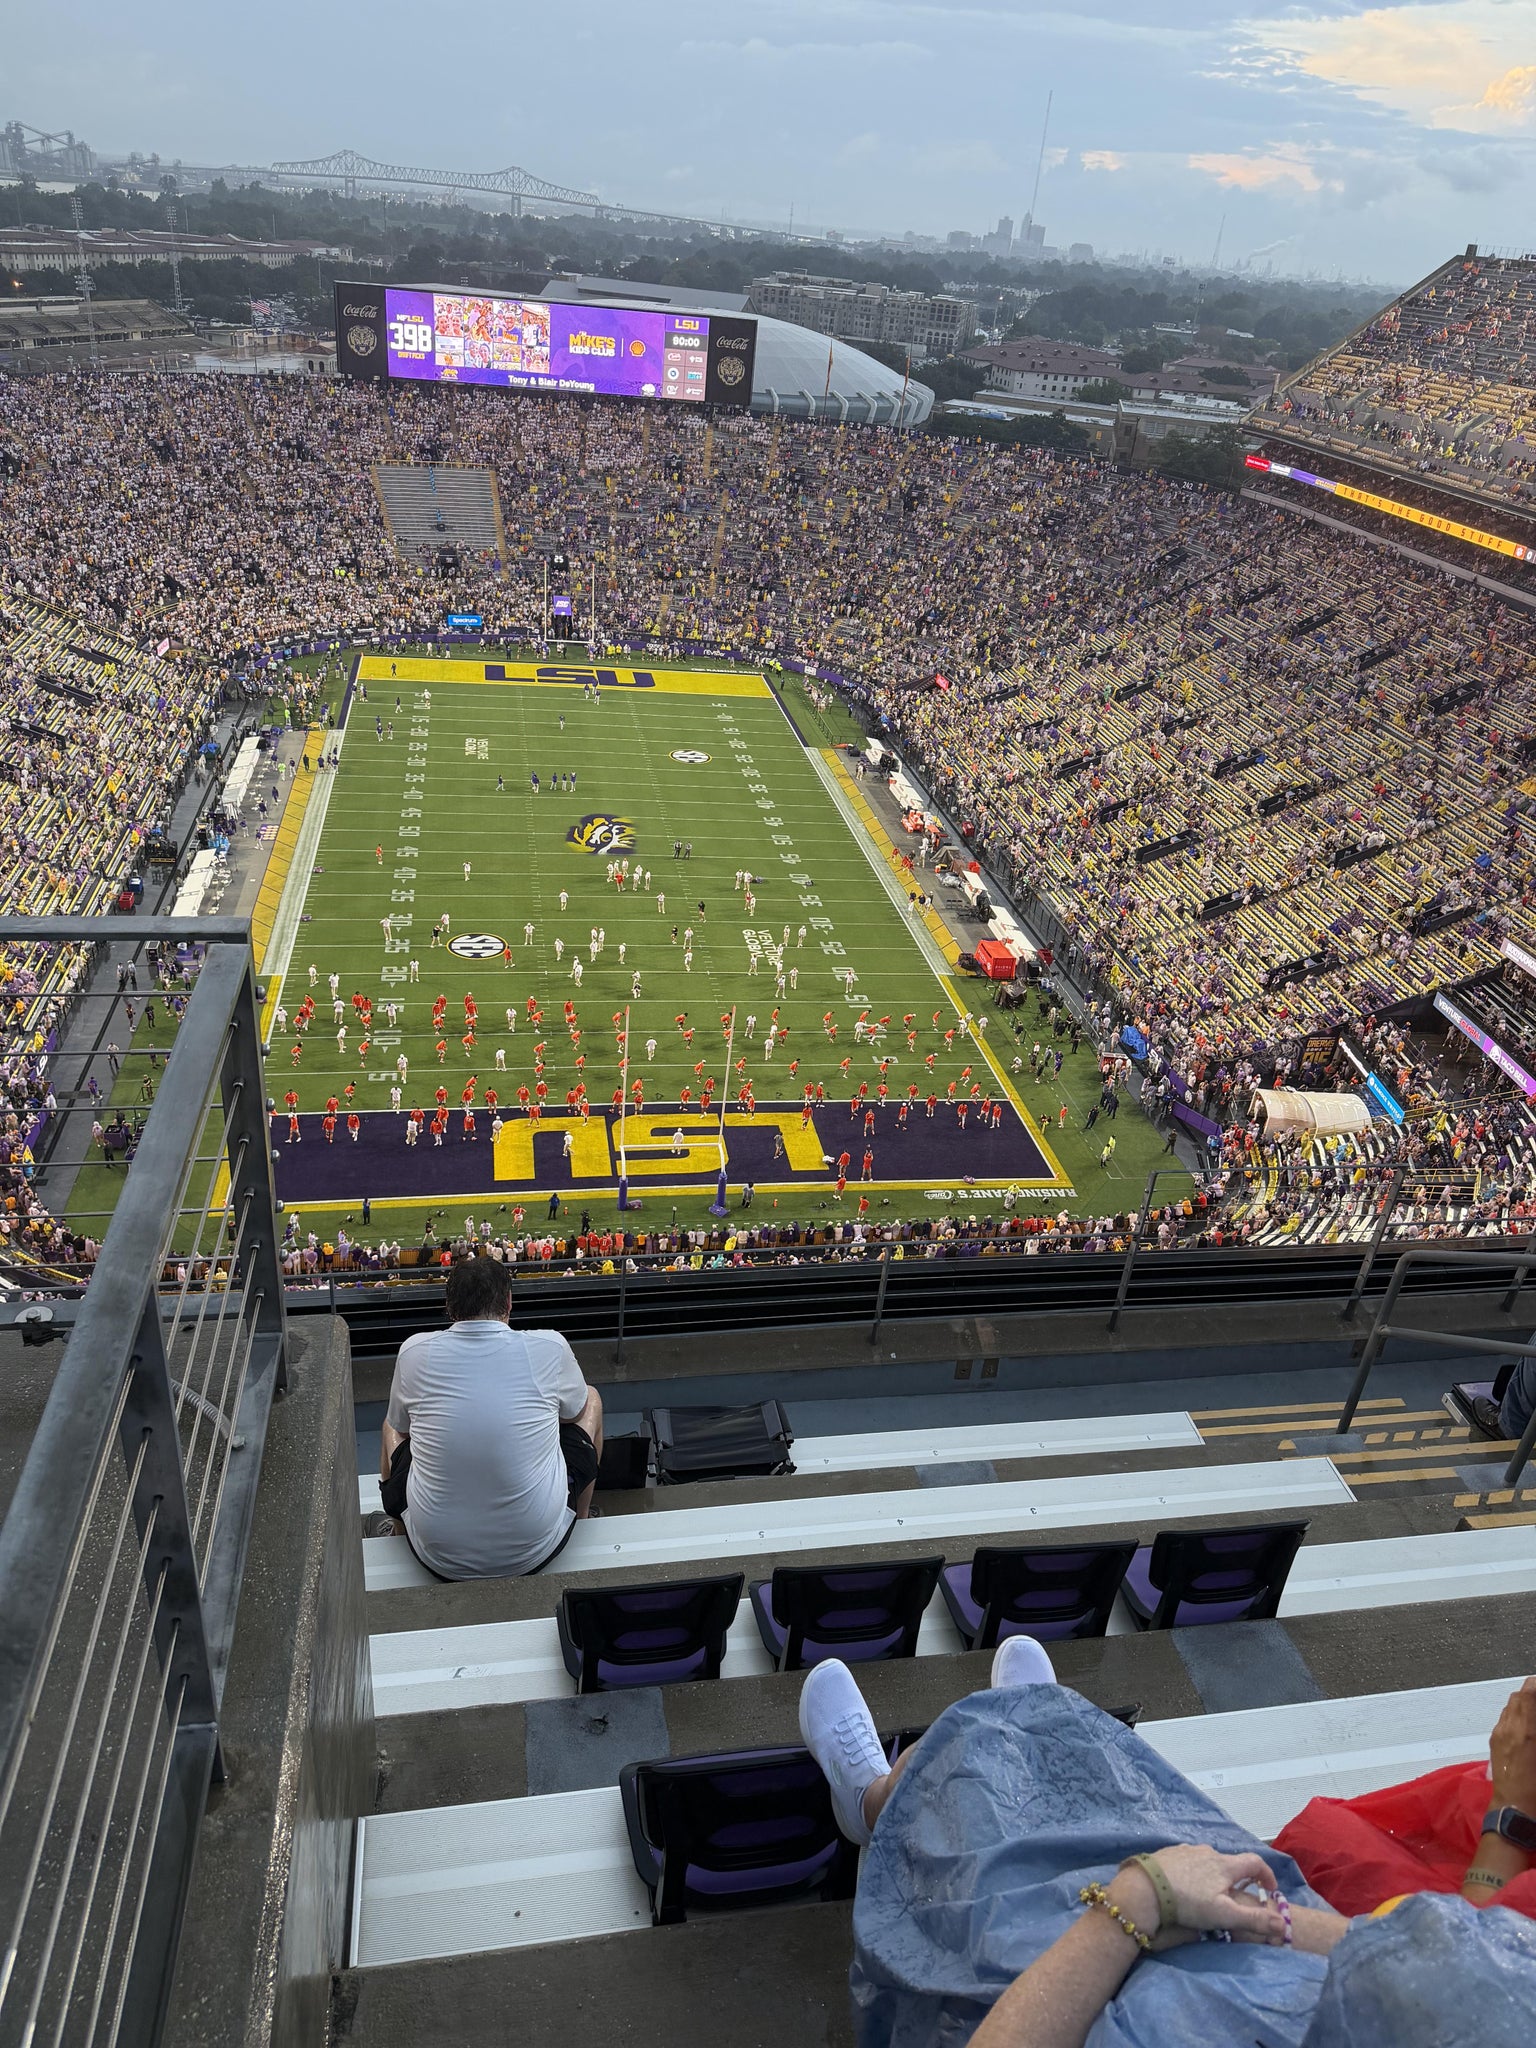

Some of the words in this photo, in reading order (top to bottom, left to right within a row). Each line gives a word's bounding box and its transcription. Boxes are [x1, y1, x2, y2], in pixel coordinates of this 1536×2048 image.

[674, 319, 699, 330] LSU
[389, 323, 433, 352] 398
[569, 333, 615, 349] MIKE'S
[569, 345, 590, 355] KIDS
[591, 347, 615, 356] CLUB
[508, 375, 528, 386] Tony
[538, 377, 558, 386] Blair
[559, 379, 595, 391] DeYoung
[1182, 481, 1194, 490] 242
[1343, 488, 1382, 507] THAT'S
[1390, 504, 1411, 517] THE
[1419, 514, 1451, 531] GOOD
[1461, 529, 1503, 548] STUFF
[1526, 551, 1533, 560] 0
[452, 617, 477, 625] Spectrum
[485, 664, 656, 688] LSU
[398, 826, 421, 837] 50
[771, 834, 793, 846] 50
[393, 867, 417, 879] 40
[390, 889, 415, 902] 35
[798, 894, 823, 907] 35
[388, 913, 413, 927] 30
[808, 917, 834, 930] 30
[384, 938, 410, 953] 25
[757, 930, 781, 966] VENTURE
[820, 941, 847, 955] 25
[380, 966, 408, 982] 20
[844, 994, 873, 1008] 15
[1438, 998, 1463, 1024] VENTURE
[1460, 1019, 1480, 1042] GLOBAL
[373, 1029, 402, 1046] 10
[368, 1072, 398, 1082] 5
[1501, 1055, 1515, 1074] TACO
[1513, 1069, 1528, 1088] BELL
[493, 1111, 830, 1182] LSU
[1030, 1507, 1037, 1515] 3
[758, 1530, 765, 1539] 5
